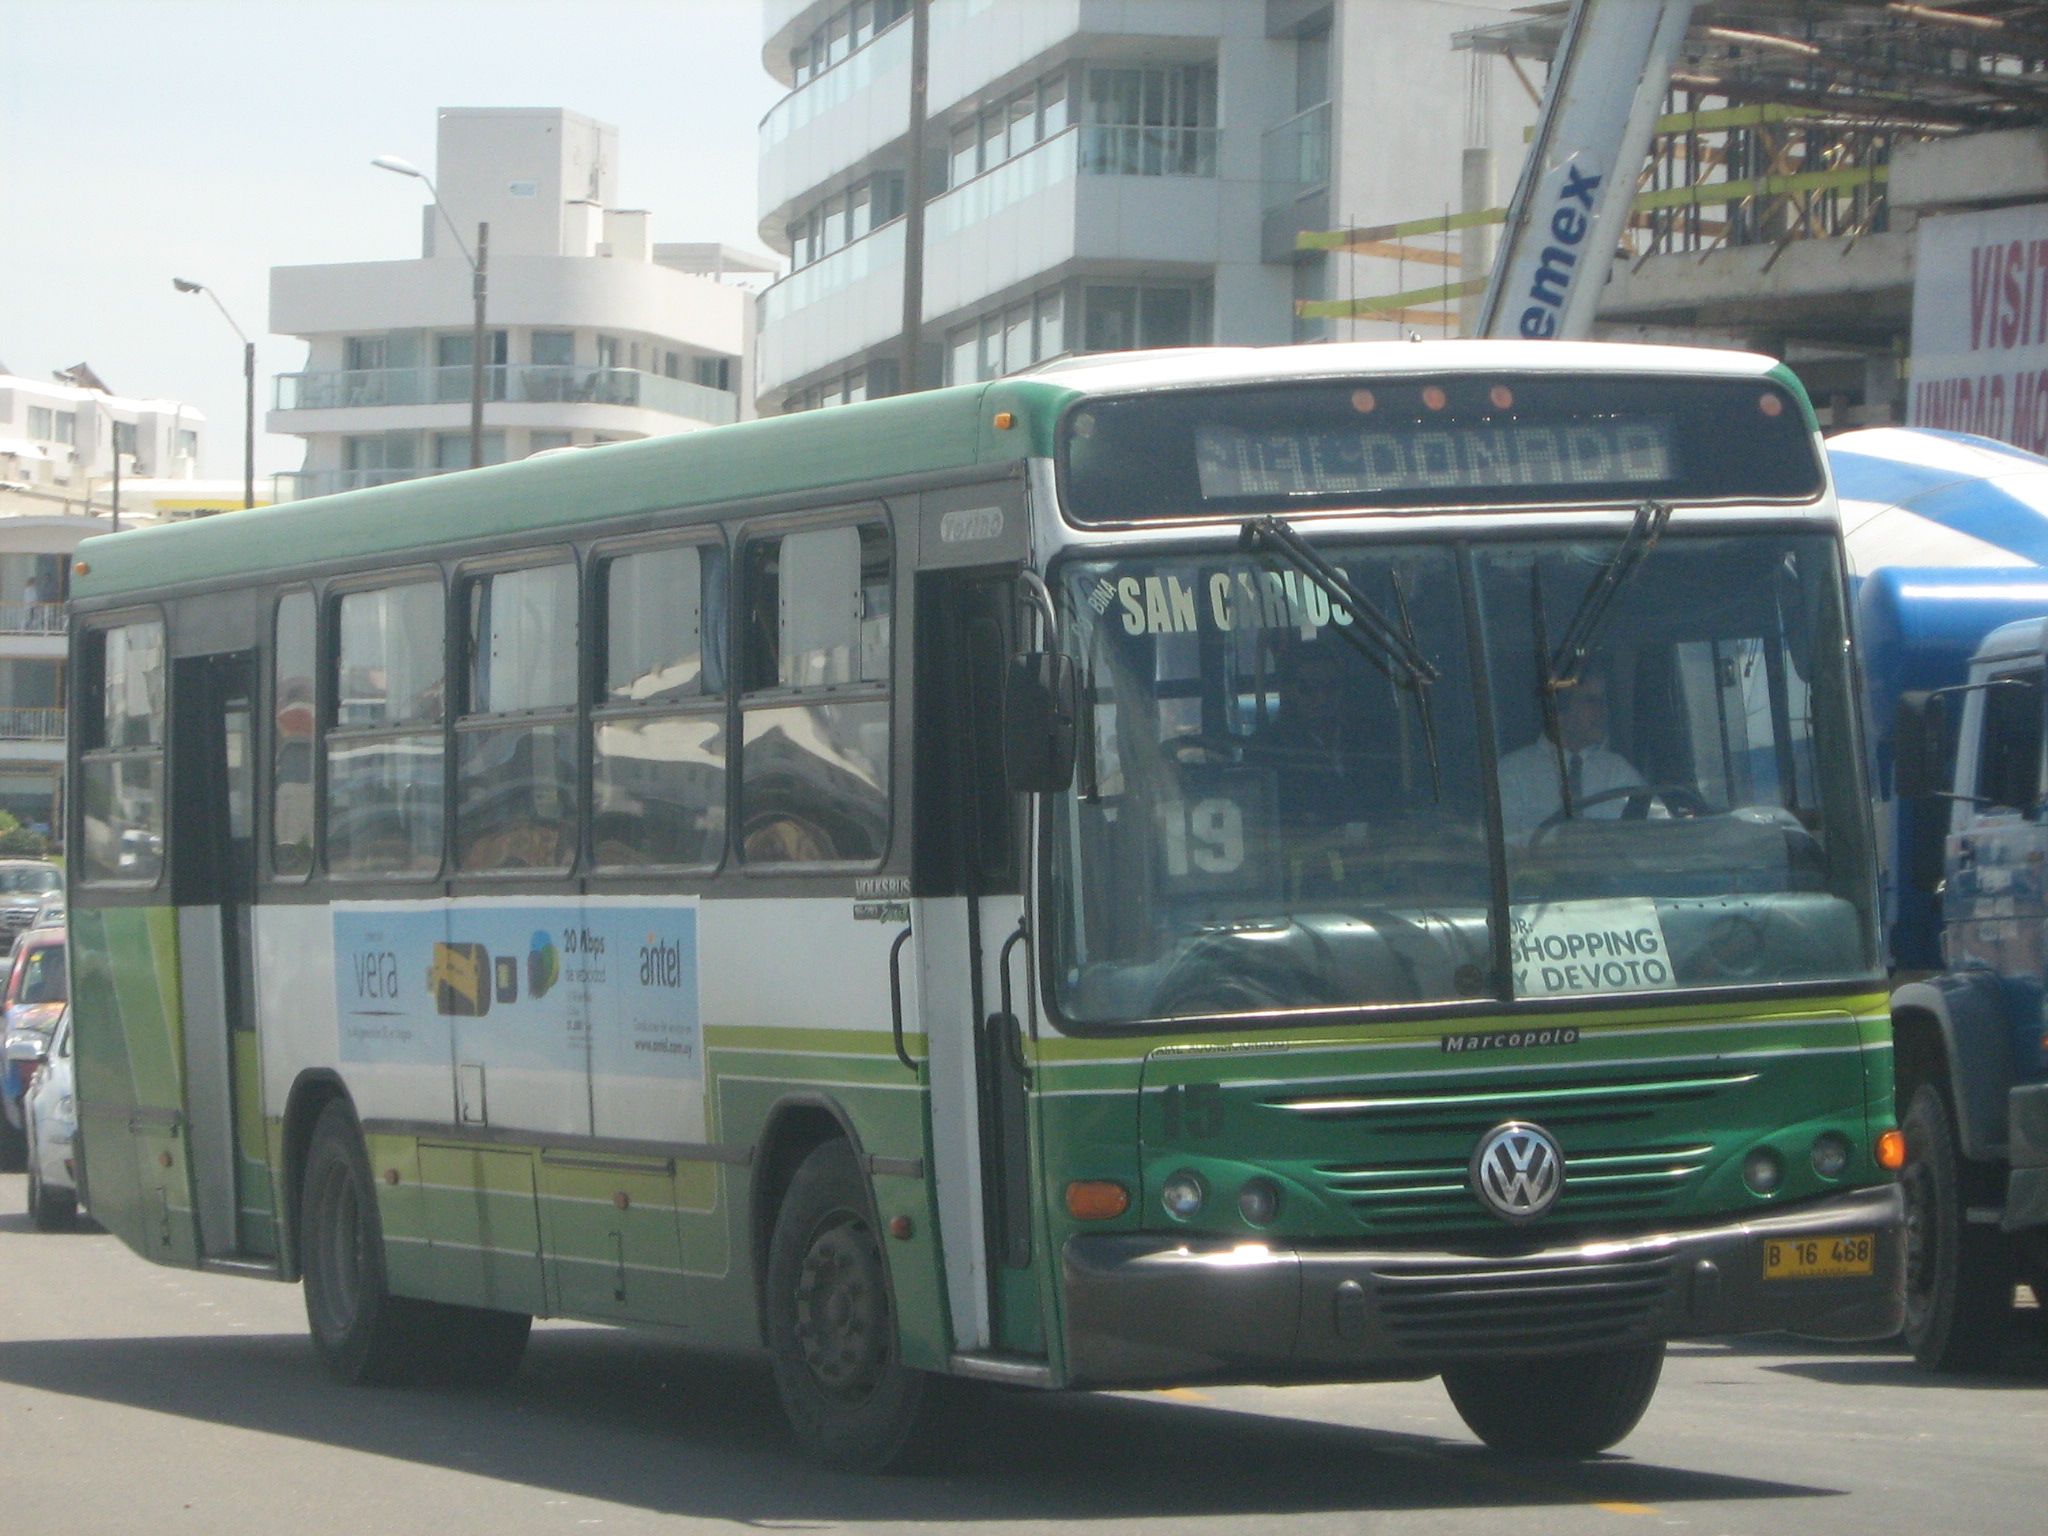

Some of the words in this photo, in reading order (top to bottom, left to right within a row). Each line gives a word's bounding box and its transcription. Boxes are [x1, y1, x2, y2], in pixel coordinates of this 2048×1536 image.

[1117, 575, 1197, 636] SAN
[1209, 567, 1354, 632] CARLOS
[1154, 798, 1244, 876] 19
[855, 878, 911, 898] VOLKSBUS
[564, 928, 577, 953] 20
[353, 952, 399, 998] vera
[639, 938, 681, 988] antel
[1541, 959, 1668, 992] DEVOTO
[1446, 1029, 1576, 1051] Marcopolo
[1769, 1245, 1781, 1267] B
[1795, 1243, 1818, 1265] 16
[1831, 1240, 1869, 1262] 468
